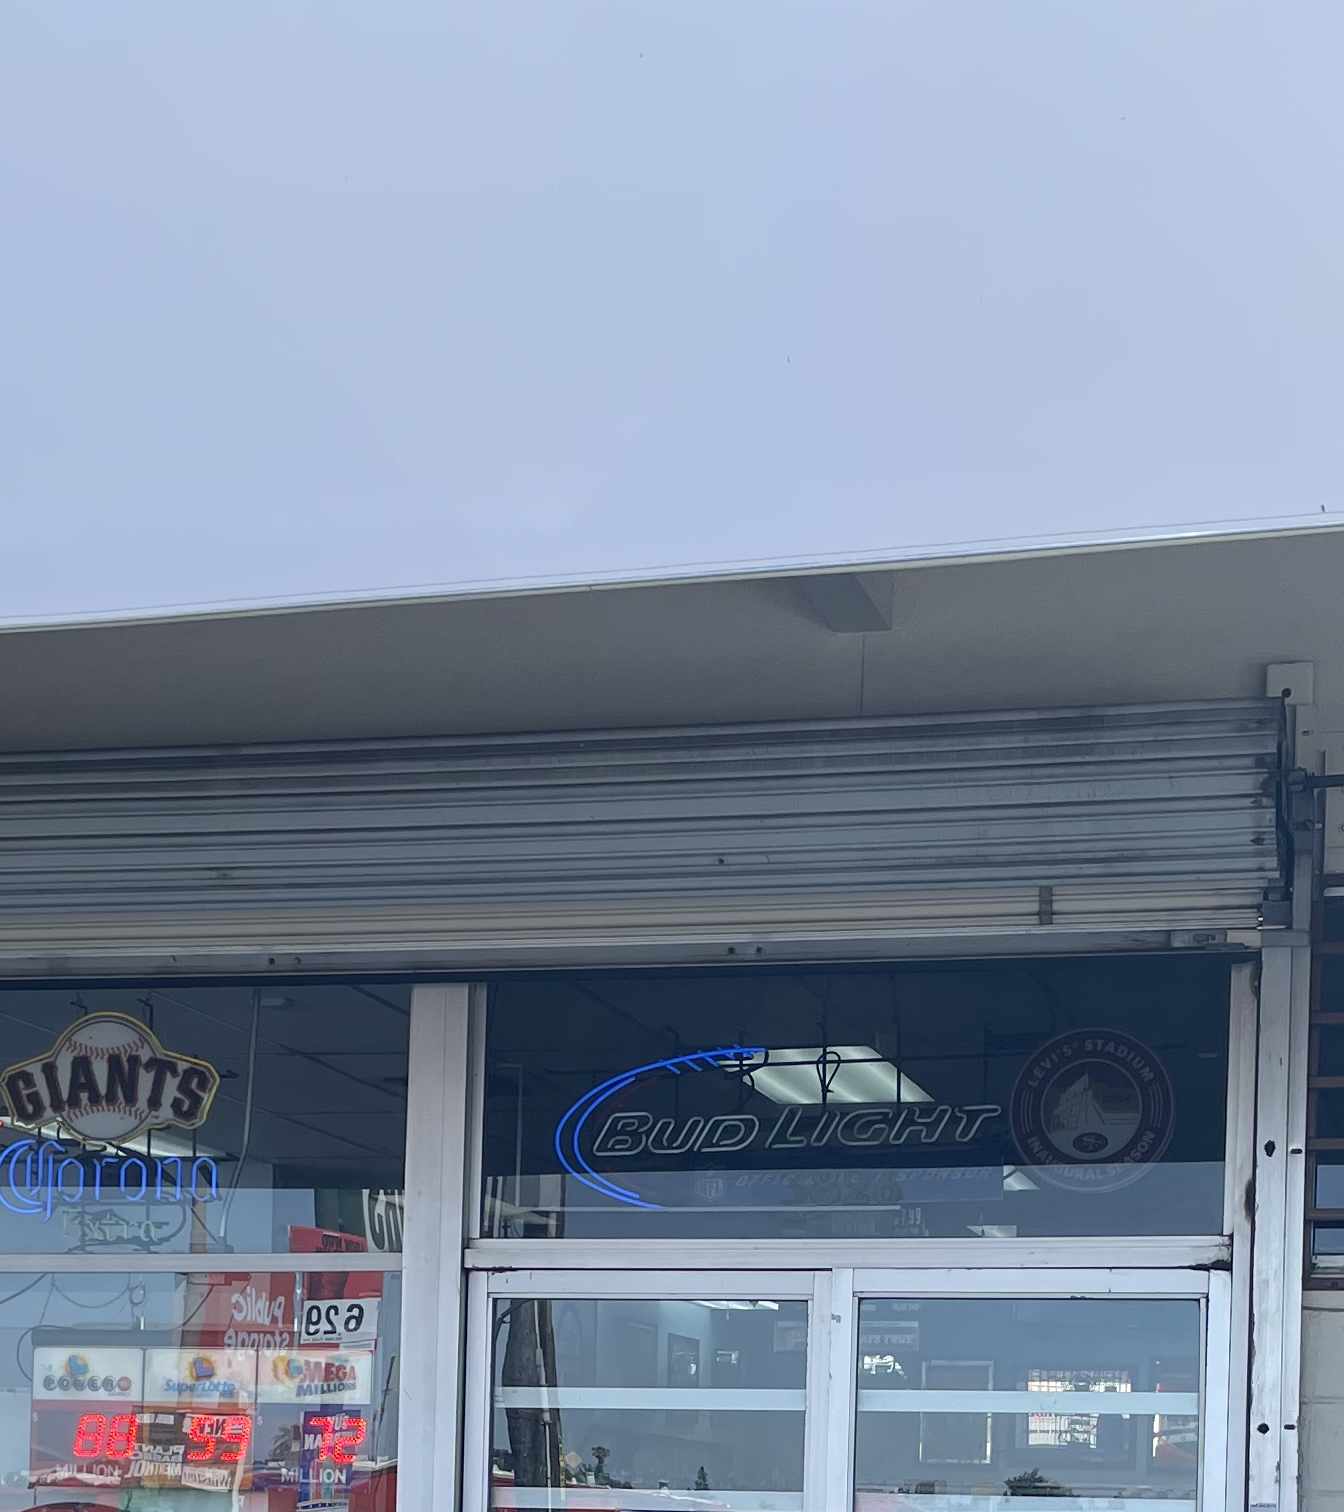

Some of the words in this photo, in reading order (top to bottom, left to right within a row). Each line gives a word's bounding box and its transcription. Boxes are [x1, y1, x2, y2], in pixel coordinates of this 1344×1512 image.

[1084, 1039, 1154, 1082] STADIUM
[5, 1053, 214, 1121] GIANTS
[592, 1111, 760, 1157] BUD
[764, 1104, 1002, 1149] LIGHT
[73, 1413, 139, 1459] 88
[187, 1416, 253, 1461] 59
[309, 1417, 367, 1463] 72
[281, 1468, 347, 1484] MILLION
